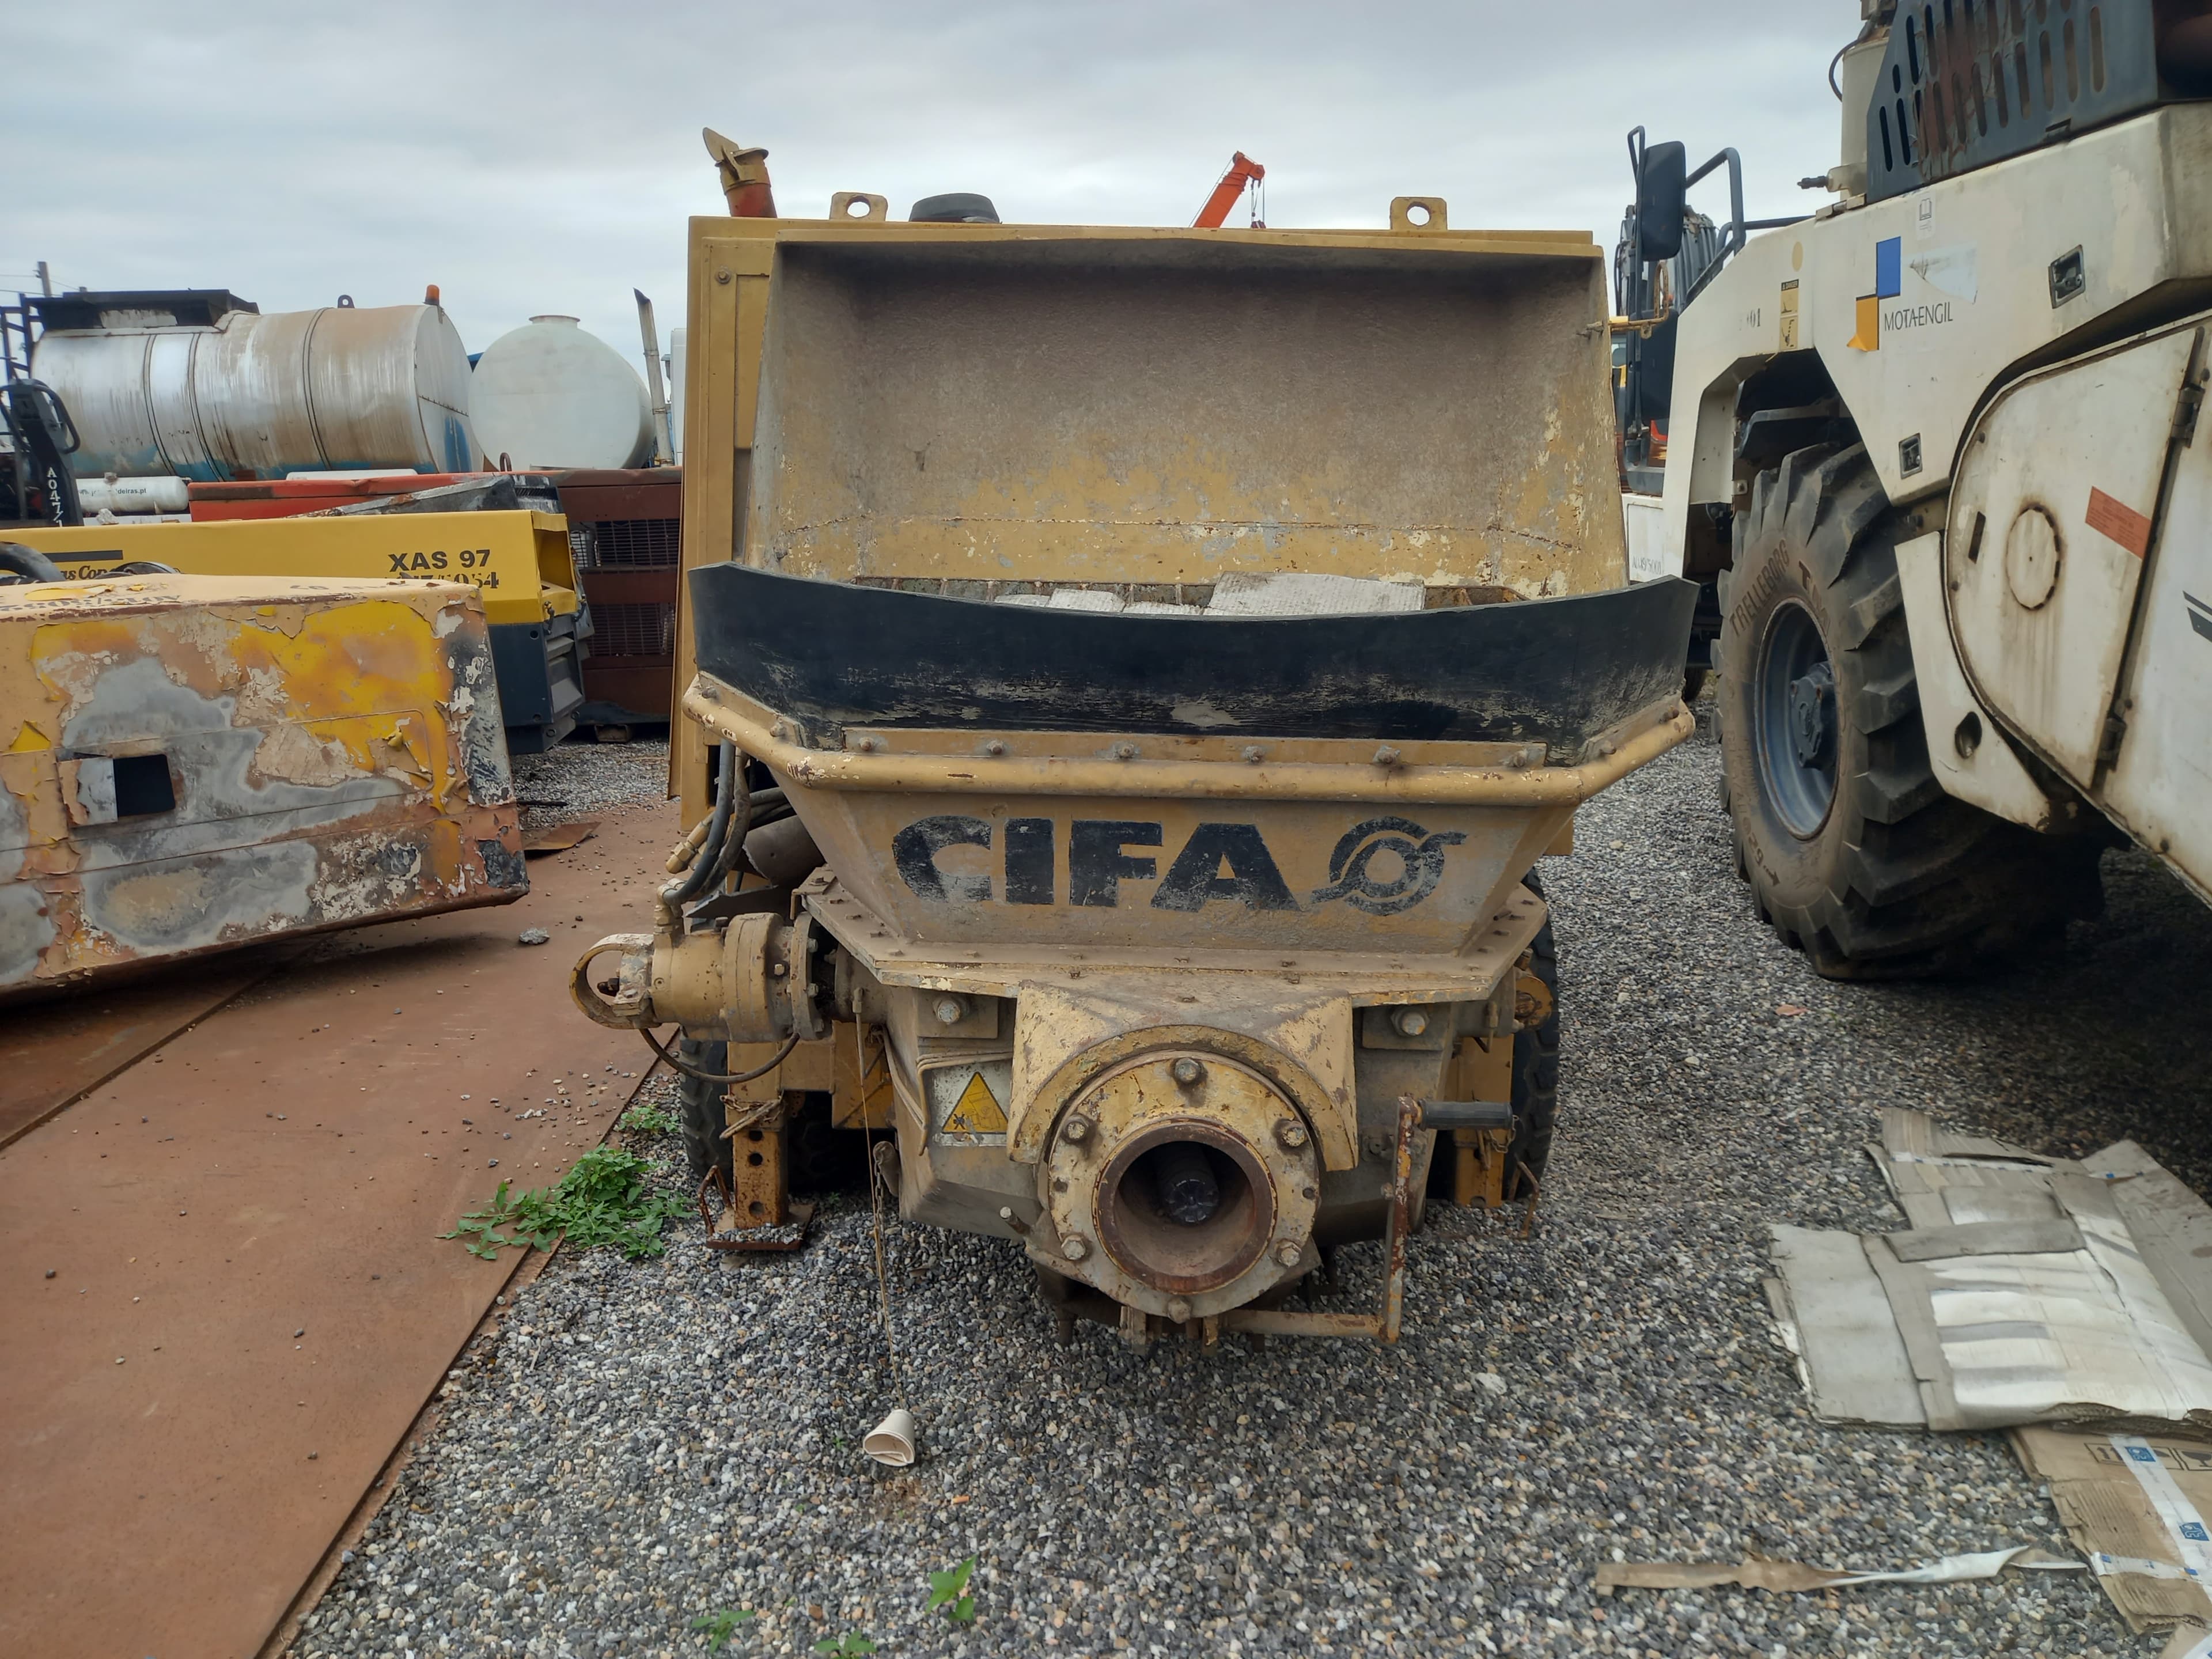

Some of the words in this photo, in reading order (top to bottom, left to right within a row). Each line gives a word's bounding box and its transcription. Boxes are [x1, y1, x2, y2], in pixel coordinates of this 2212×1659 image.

[388, 551, 448, 572] XAS
[459, 549, 491, 568] 97
[892, 815, 1302, 914] CIFA
